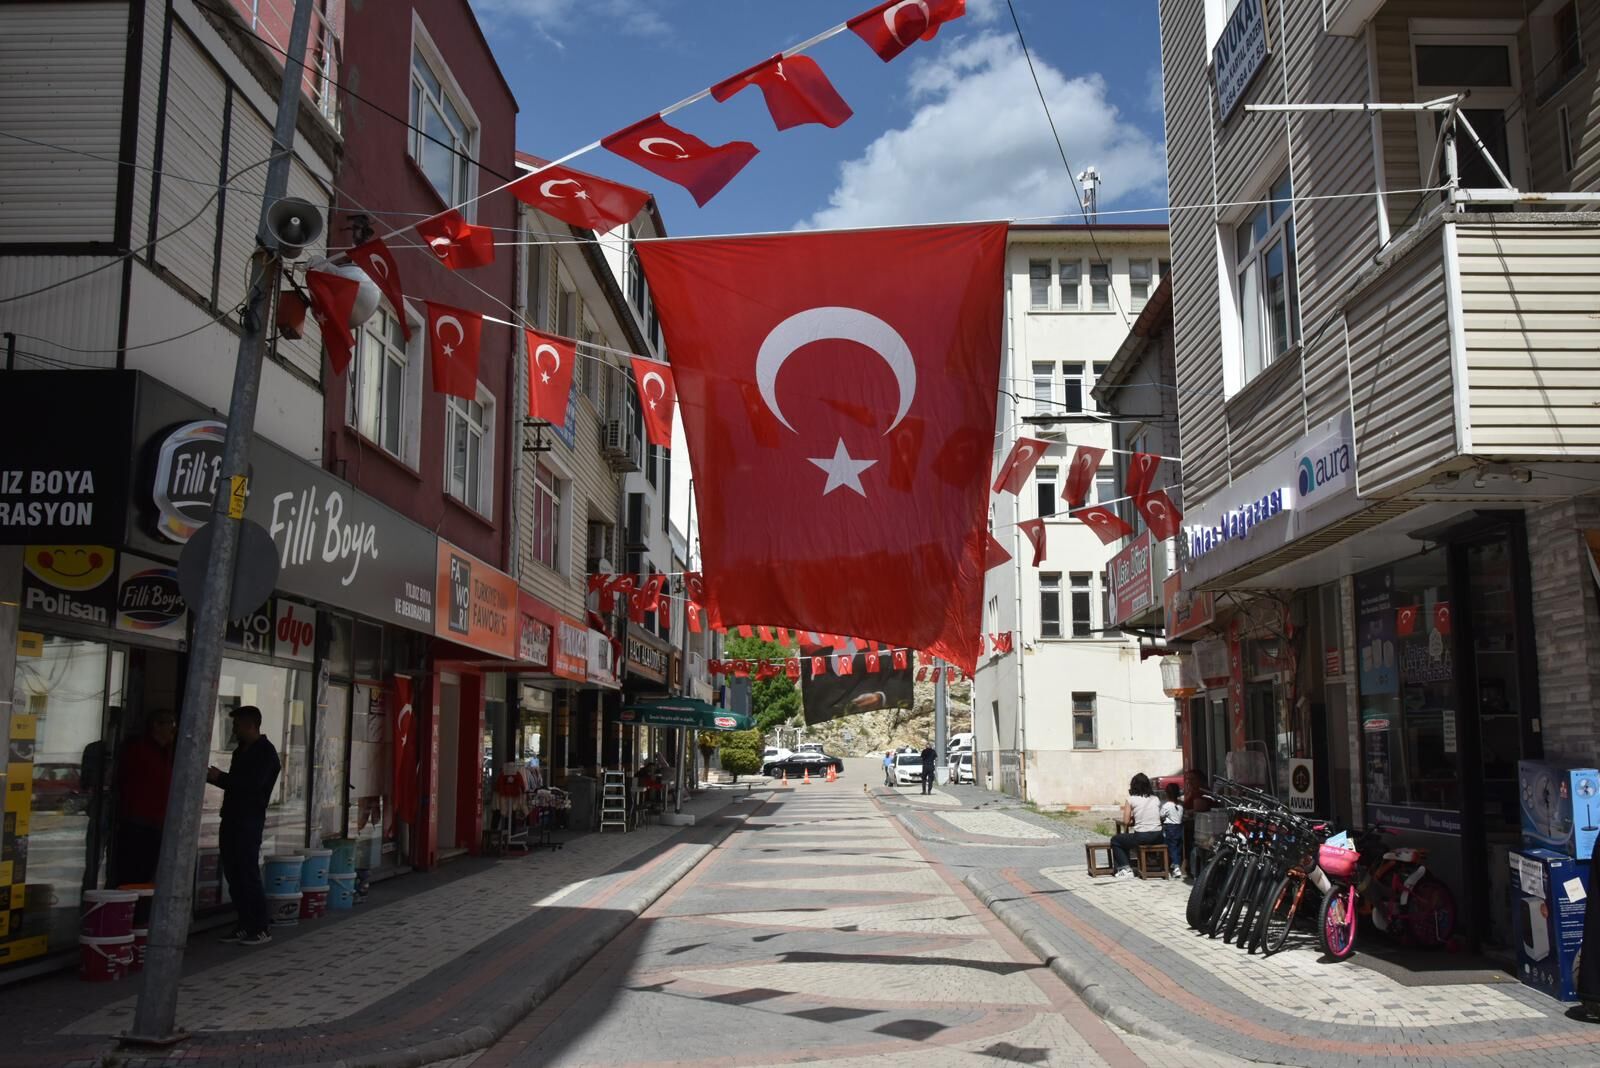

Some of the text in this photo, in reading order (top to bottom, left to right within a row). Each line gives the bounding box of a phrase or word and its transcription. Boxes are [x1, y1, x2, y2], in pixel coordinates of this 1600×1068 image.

[173, 450, 208, 495] Filli
[1316, 444, 1350, 486] aura
[30, 470, 95, 494] BOYA
[0, 501, 93, 527] RASYON
[270, 484, 378, 586] Filli Boya
[26, 587, 107, 622] Polisan
[122, 585, 184, 612] Filli Boya
[243, 631, 264, 652] RI
[278, 605, 313, 656] dyo
[1290, 795, 1313, 809] AVUKAT
